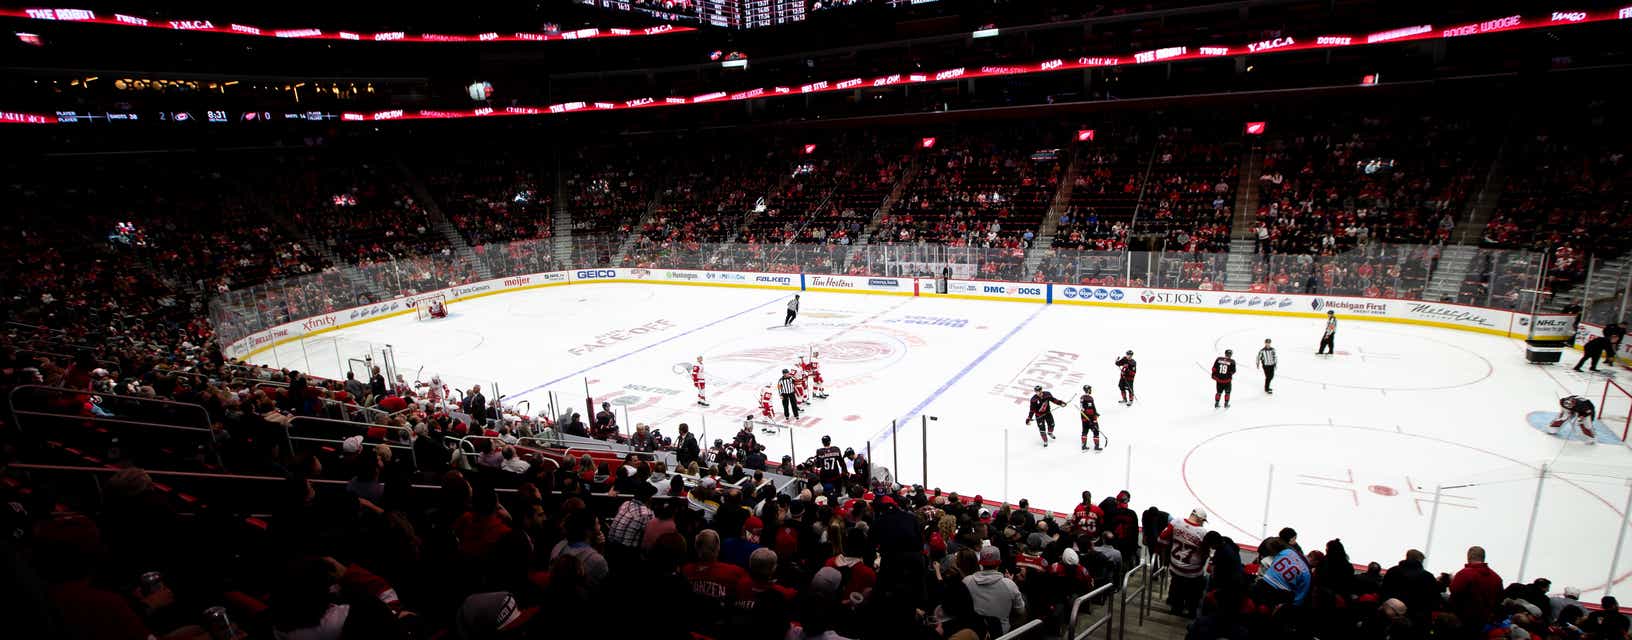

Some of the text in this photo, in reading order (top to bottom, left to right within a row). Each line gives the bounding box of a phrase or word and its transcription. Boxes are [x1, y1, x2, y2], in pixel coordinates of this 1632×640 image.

[26, 9, 55, 20] THE
[1551, 11, 1587, 21] TANGO
[1480, 14, 1522, 33] WOOGIE
[1134, 52, 1155, 64] THE
[1041, 58, 1063, 70] SALSA
[207, 110, 227, 119] 8:31
[264, 112, 271, 120] 0
[577, 269, 616, 280] GEICO
[755, 275, 791, 284] FALKEN
[504, 276, 531, 288] meijer
[811, 276, 854, 289] Tim Hortons
[983, 285, 1005, 294] DMC
[1018, 287, 1041, 296] DOCS
[1325, 300, 1387, 311] Michigan First
[302, 315, 338, 332] xfinity
[1219, 364, 1229, 375] 19
[823, 457, 835, 471] 57
[1273, 556, 1302, 583] 66
